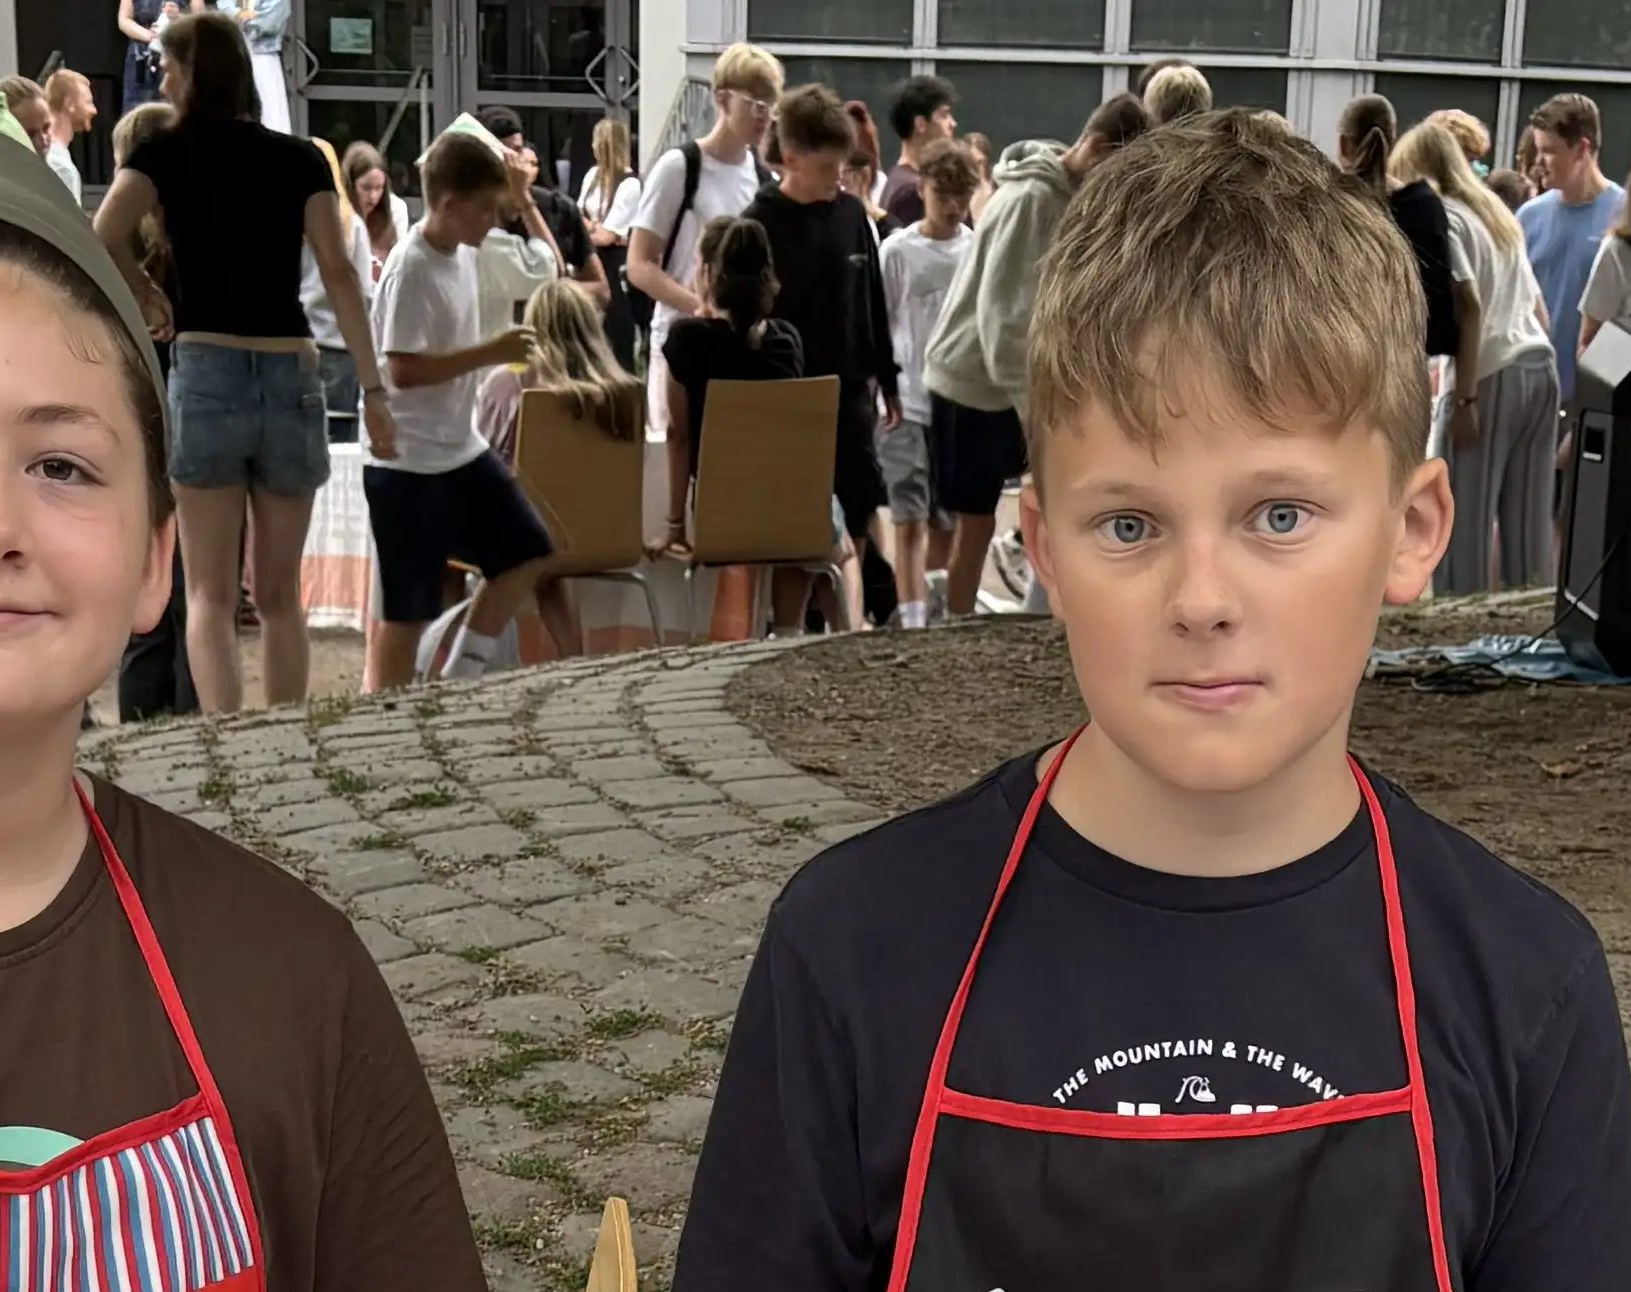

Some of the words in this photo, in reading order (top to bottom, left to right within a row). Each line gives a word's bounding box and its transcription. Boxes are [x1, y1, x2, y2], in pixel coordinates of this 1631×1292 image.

[1053, 1068, 1089, 1104] THE
[1094, 1038, 1213, 1074] MOUNTAIN
[1222, 1041, 1237, 1059] &
[1247, 1045, 1286, 1072] THE
[1291, 1062, 1345, 1101] WAV
